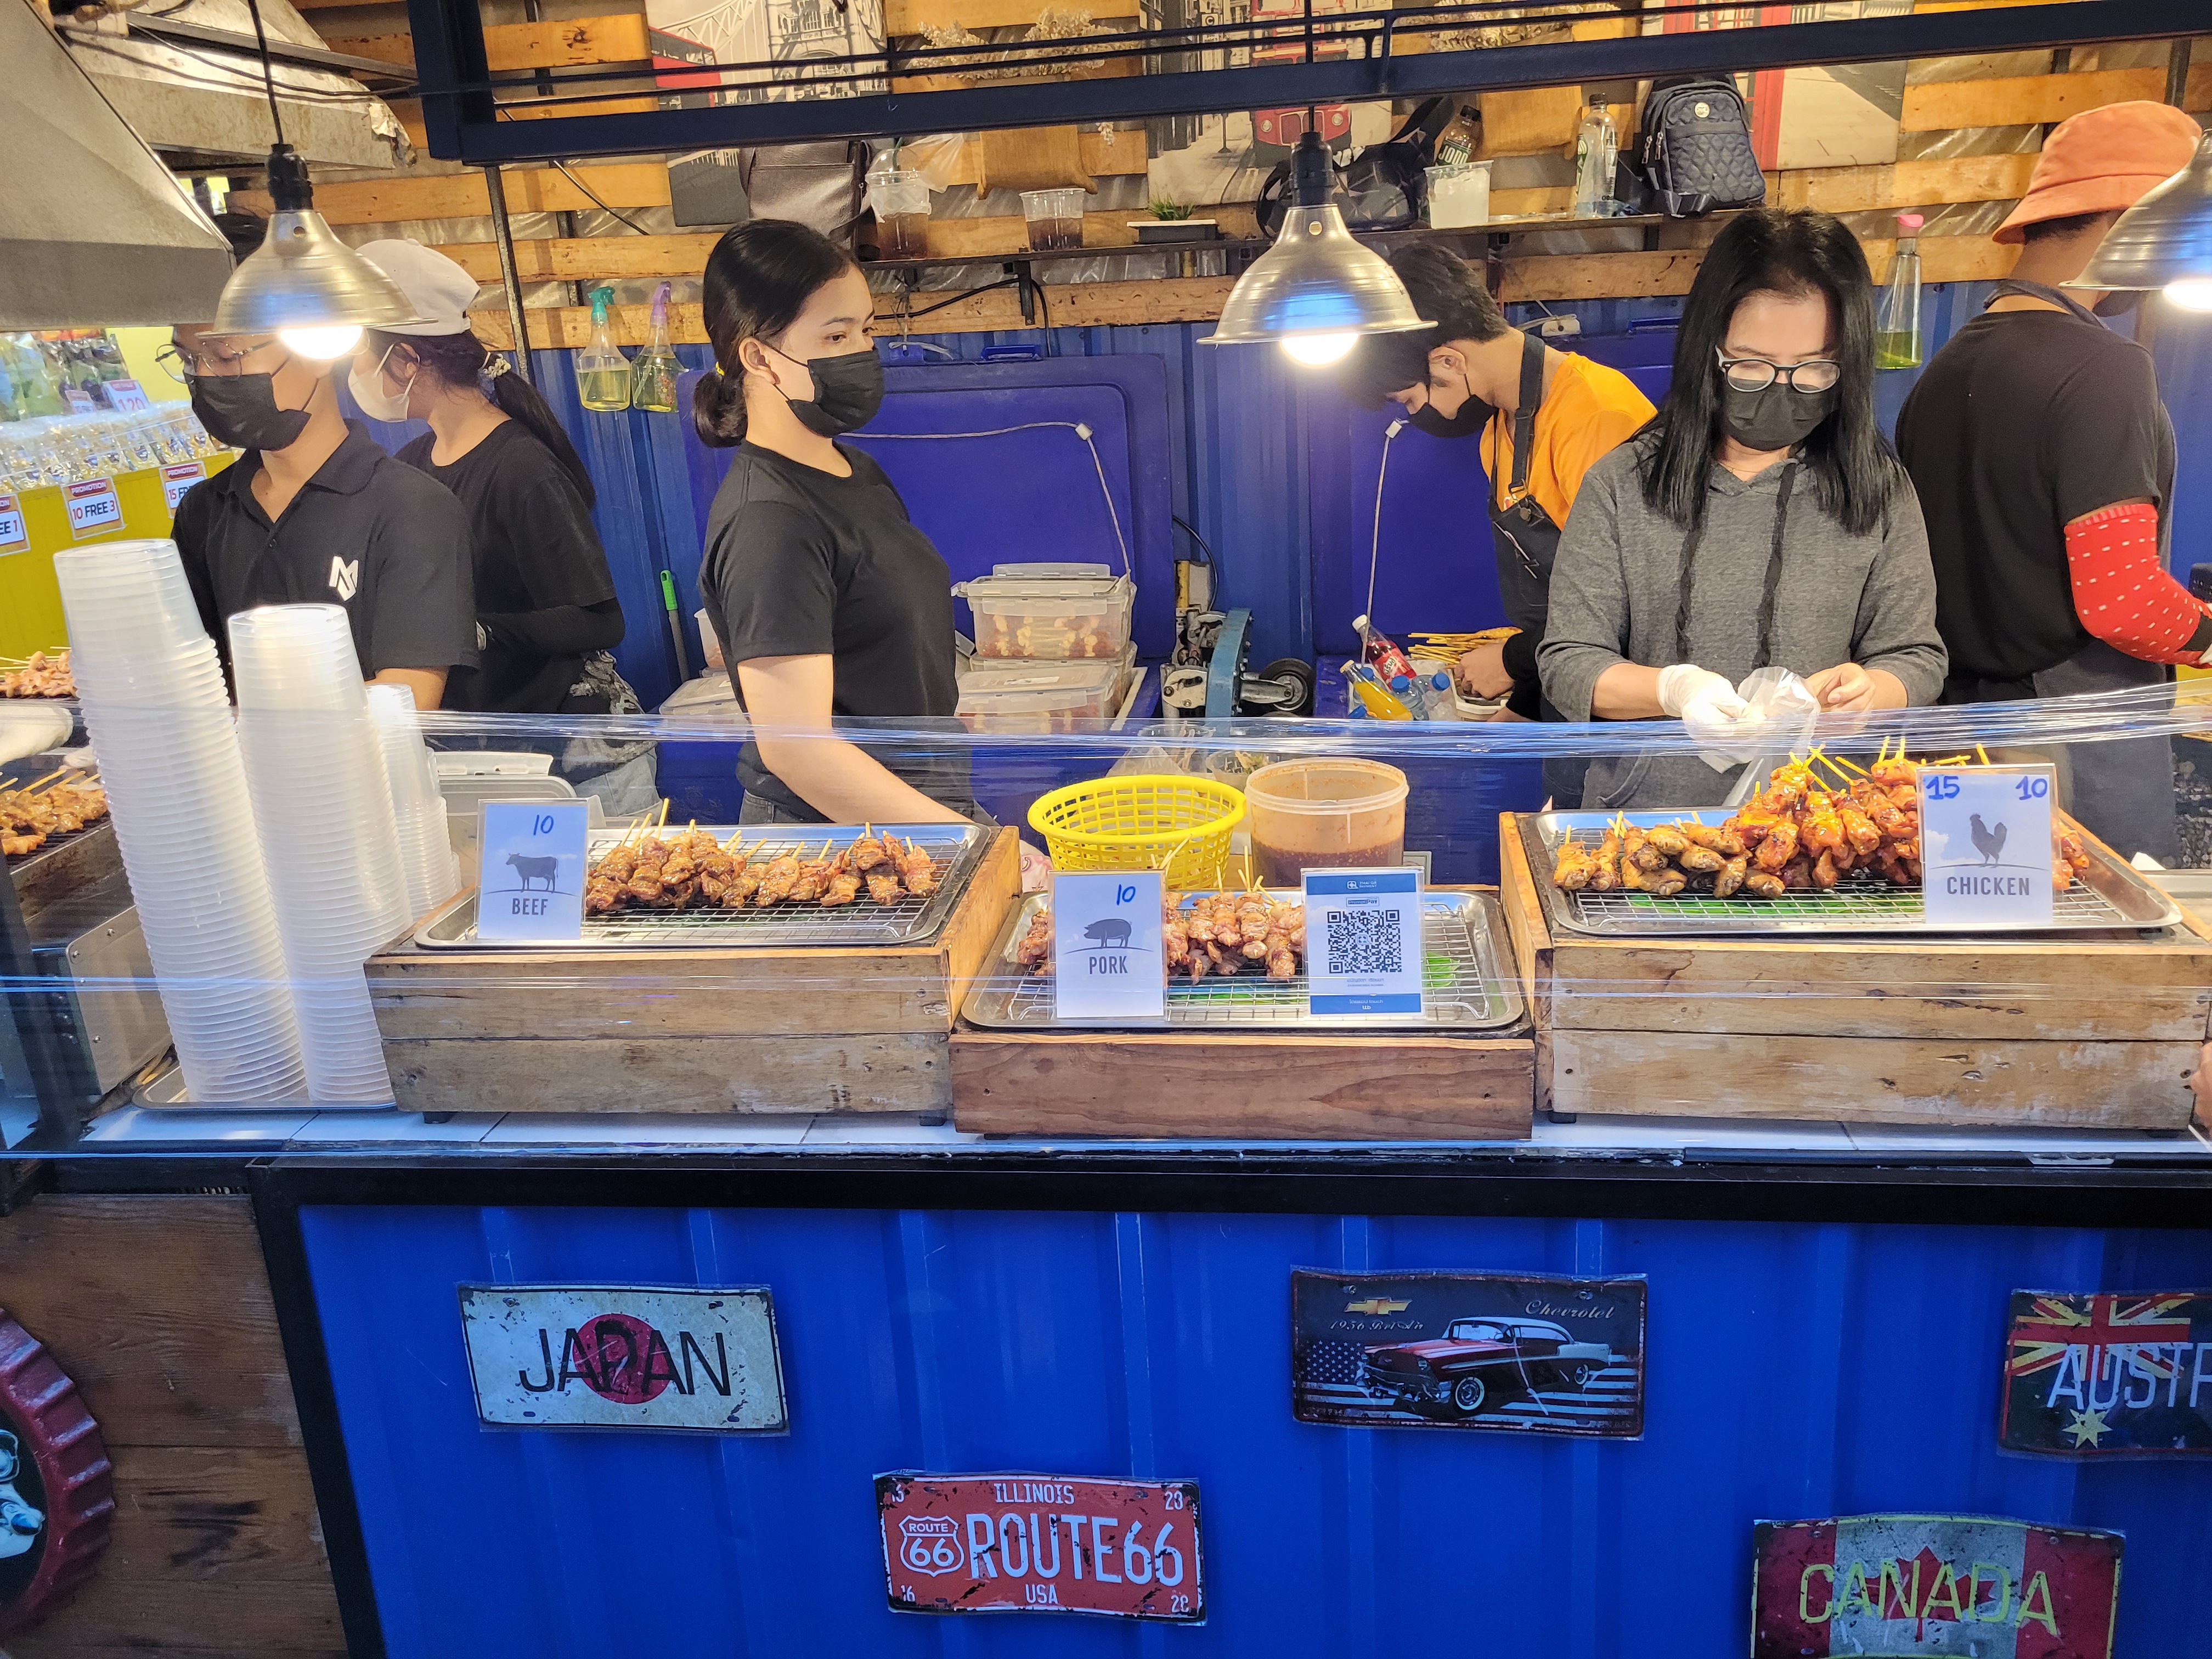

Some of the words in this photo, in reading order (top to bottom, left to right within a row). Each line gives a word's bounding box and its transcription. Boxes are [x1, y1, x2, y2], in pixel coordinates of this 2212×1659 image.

[71, 482, 106, 494] PROMOTION
[168, 488, 177, 500] 15
[72, 507, 83, 520] 10
[84, 501, 109, 518] FREE
[109, 500, 116, 512] 3
[13, 520, 18, 532] 1
[1926, 776, 1960, 800] 15
[2015, 776, 2047, 800] 10
[533, 814, 554, 836] 10
[1116, 884, 1136, 906] 10
[1947, 876, 2030, 896] CHICKEN
[512, 898, 548, 916] BEEF
[1089, 956, 1128, 974] PORK
[518, 1320, 731, 1396] JAPAN
[994, 1482, 1075, 1505] ILLINOIS
[909, 1523, 949, 1533] ROUTE
[909, 1537, 955, 1567] 66
[900, 1584, 916, 1602] 16
[1025, 1584, 1059, 1605] USA
[1799, 1559, 2059, 1637] CANADA
